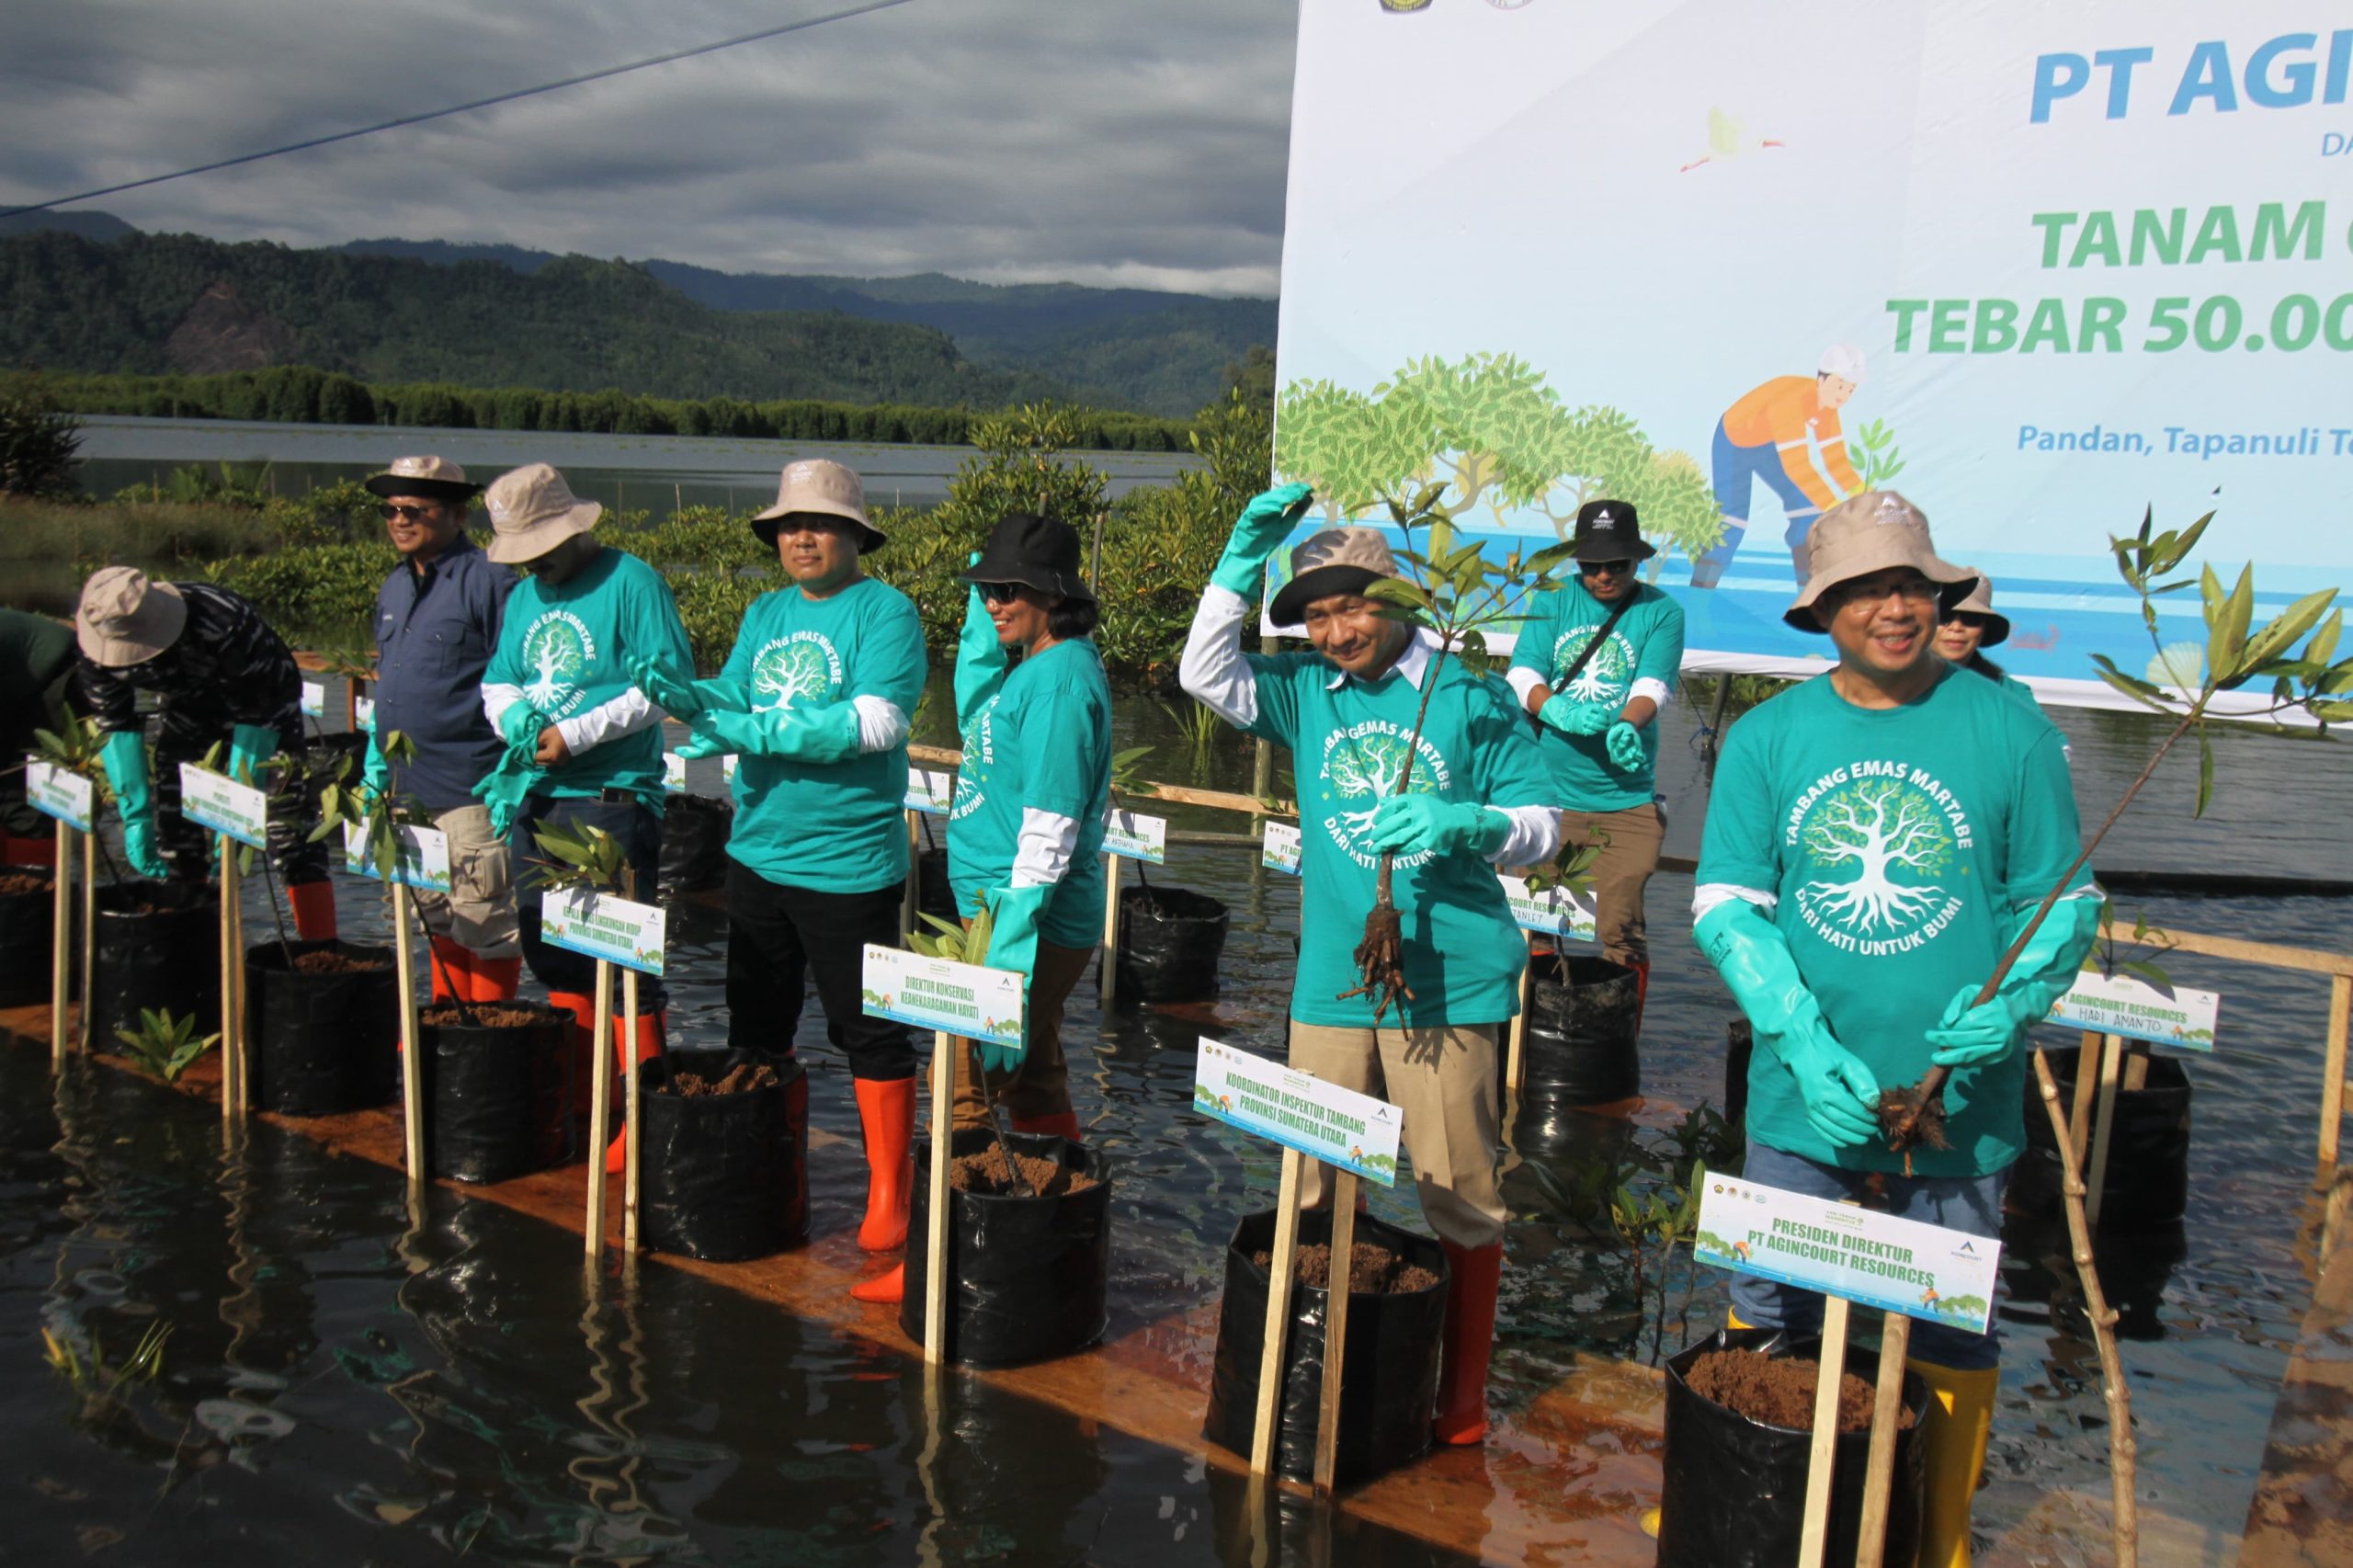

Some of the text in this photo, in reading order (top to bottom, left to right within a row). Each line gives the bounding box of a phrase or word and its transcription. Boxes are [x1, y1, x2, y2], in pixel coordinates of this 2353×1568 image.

[2029, 47, 2154, 123] PT
[2031, 200, 2326, 268] TANAM
[1885, 296, 2128, 354] TEBAR
[2018, 425, 2154, 457] Pandan,
[2163, 427, 2320, 460] Tapanuli
[1358, 720, 1398, 737] EMAS
[961, 791, 985, 817] BUMI
[1786, 760, 1973, 849] TAMBANG EMAS MARTABE
[1324, 817, 1349, 851] DARI
[1348, 846, 1376, 870] HATI
[1794, 887, 1963, 955] DARI HATI UNTUK BUMI
[900, 991, 979, 1020] KEANEKARAGAMAN HAYATI
[905, 975, 974, 1003] DIREKTUR KONSERVASI
[2068, 993, 2127, 1012] AGINCOURT
[2129, 1003, 2188, 1024] RESOURCES
[1225, 1072, 1280, 1105] KOORDINATOR
[1280, 1092, 1324, 1121] INSPEKTUR
[1325, 1108, 1366, 1136] TAMBANG
[1239, 1095, 1347, 1148] PROVINSI SUMATERA UTARA
[1747, 1230, 1935, 1288] PT AGINCOURT RESOURCES
[1771, 1218, 1839, 1247] PRESIDEN
[1841, 1233, 1913, 1264] DIREKTUR
